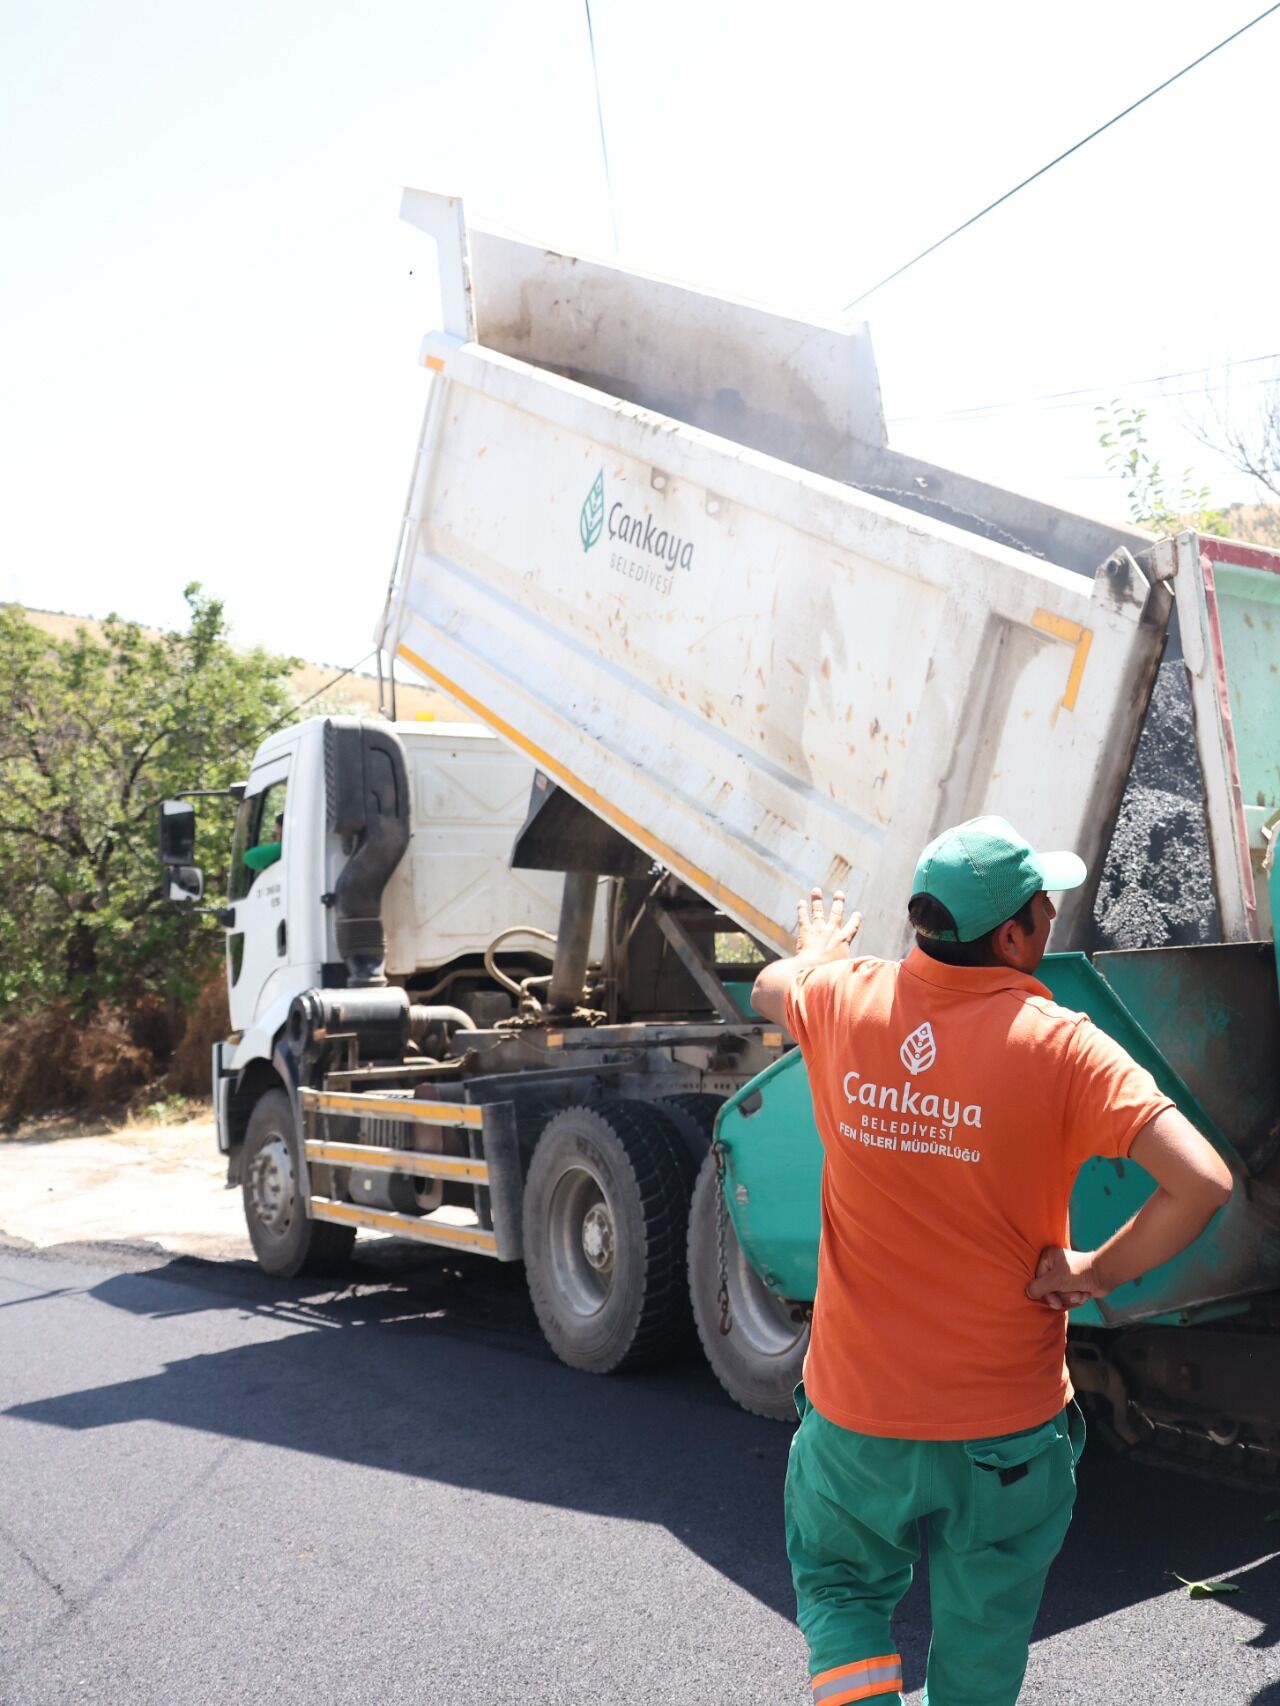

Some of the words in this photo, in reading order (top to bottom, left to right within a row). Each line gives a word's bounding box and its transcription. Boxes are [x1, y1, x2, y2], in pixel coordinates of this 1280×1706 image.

[608, 501, 695, 572] Çankaya
[610, 552, 675, 596] BELEDİYESİ
[843, 1071, 982, 1129] Çankaya
[839, 1122, 857, 1140] FEN
[859, 1128, 897, 1151] İŞLERİ
[901, 1139, 981, 1163] MÜDÜRLÜĞÜ
[861, 1114, 953, 1142] BELEDİYESİ
